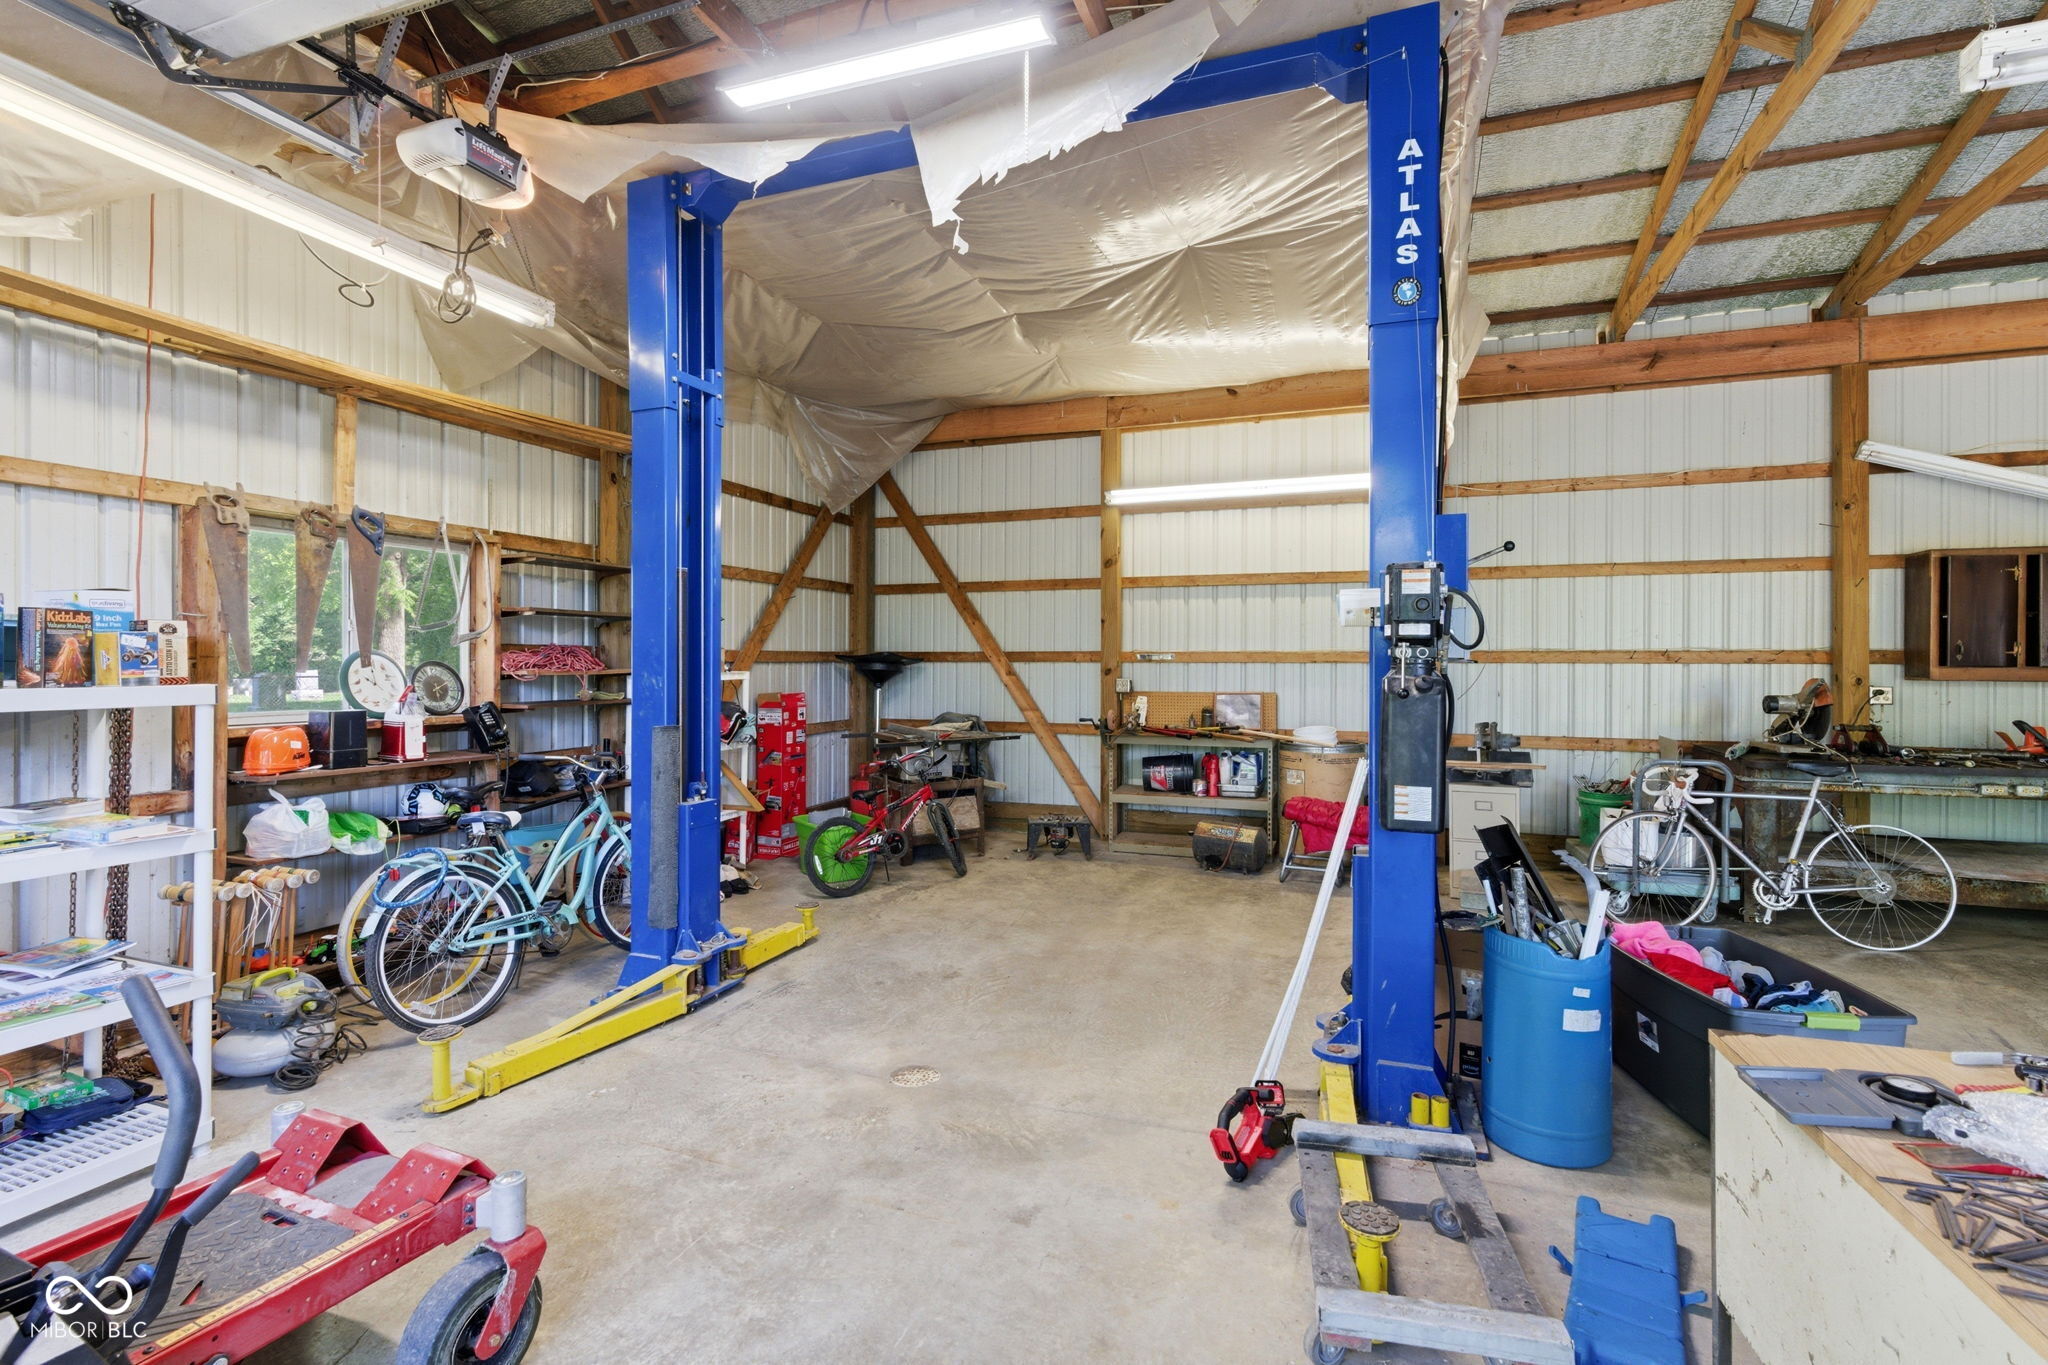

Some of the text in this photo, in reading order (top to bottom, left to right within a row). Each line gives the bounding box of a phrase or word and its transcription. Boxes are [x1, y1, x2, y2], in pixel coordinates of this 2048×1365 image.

[1395, 138, 1424, 265] ATLAS
[46, 609, 92, 624] KidzLabs
[102, 614, 122, 622] Inch
